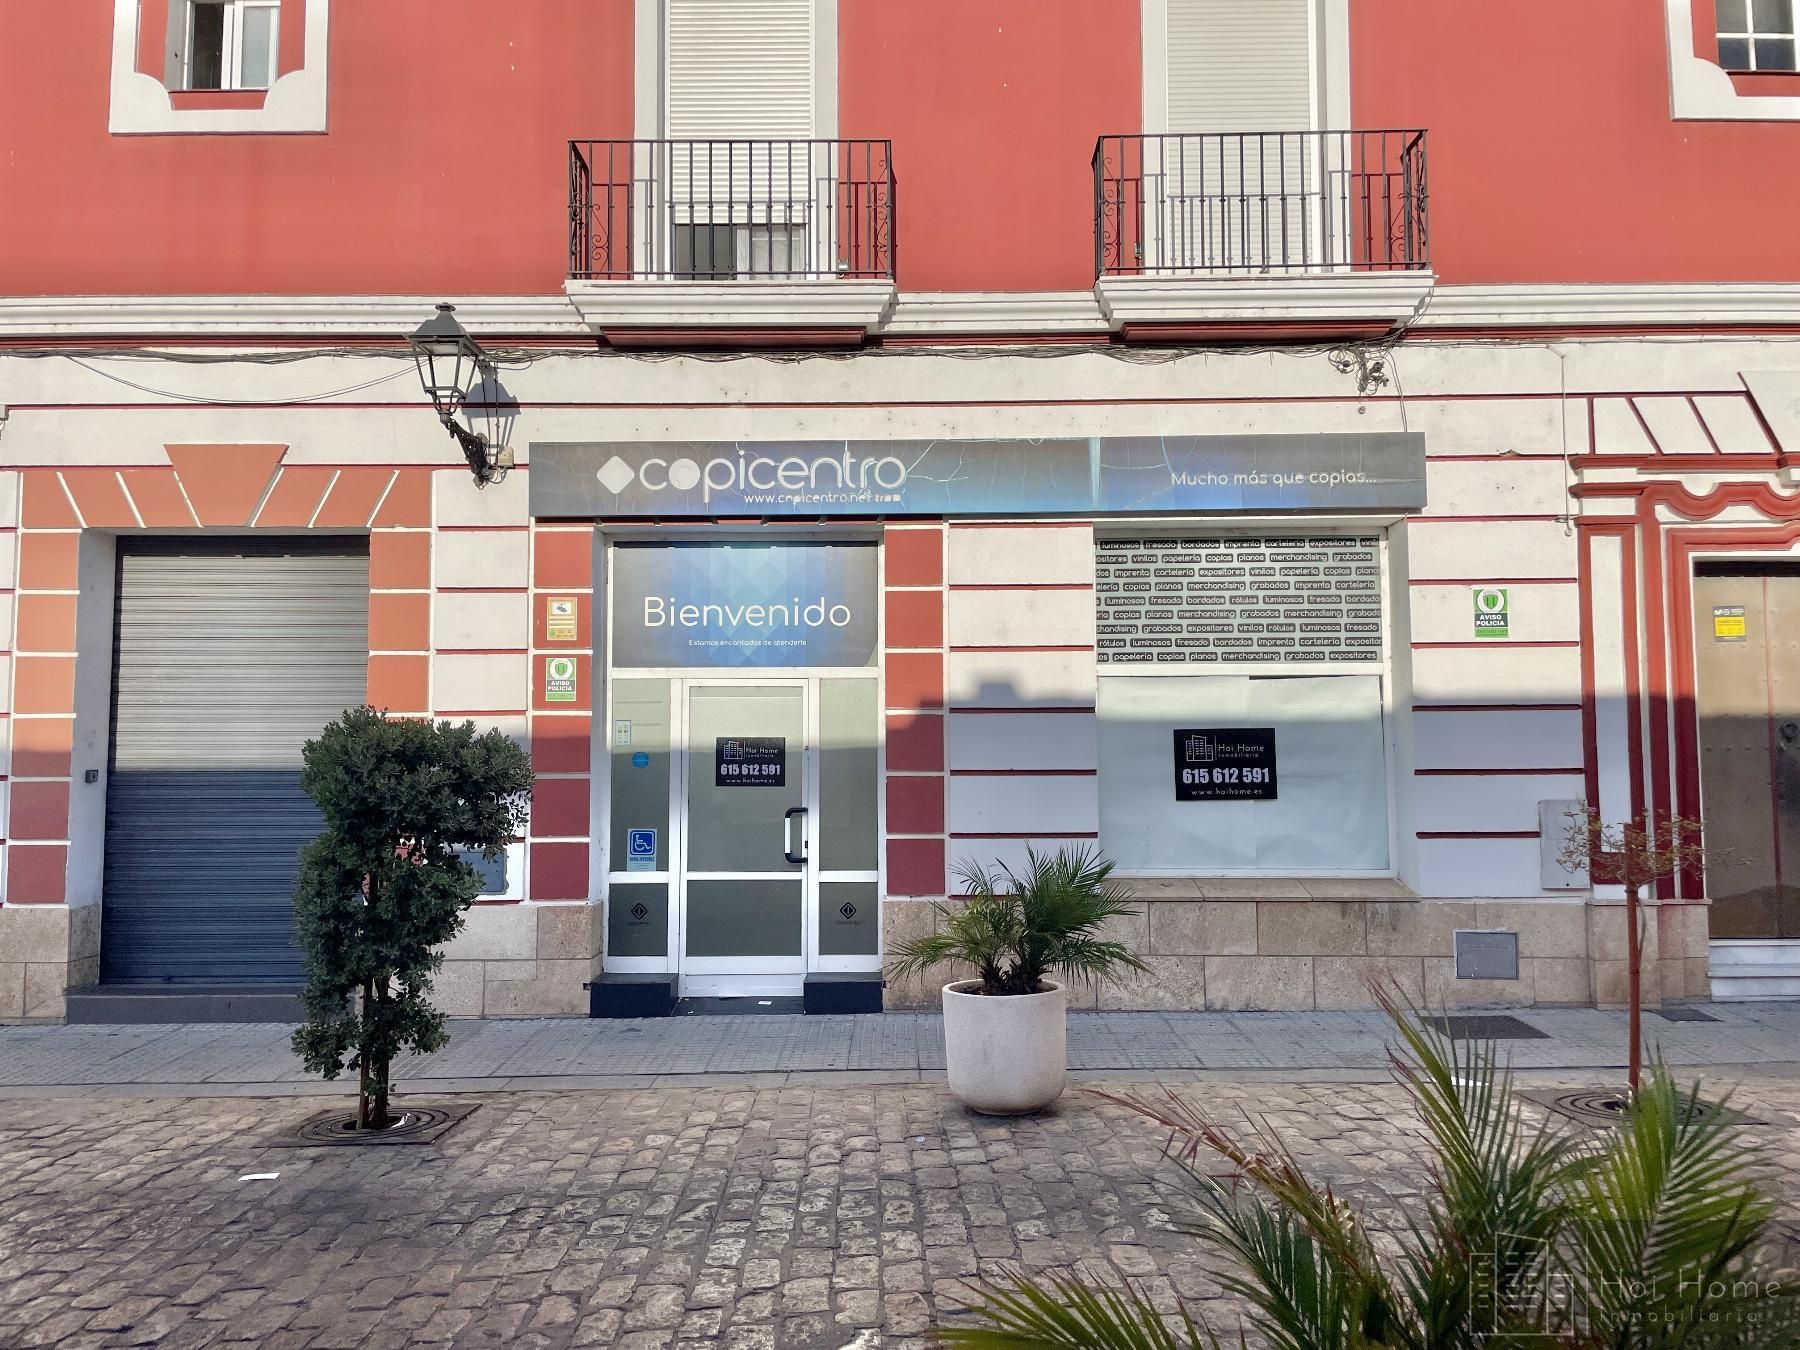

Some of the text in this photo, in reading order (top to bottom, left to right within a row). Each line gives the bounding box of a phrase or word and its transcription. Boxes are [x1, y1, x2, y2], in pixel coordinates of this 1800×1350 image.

[639, 450, 905, 503] copicentro
[1171, 471, 1227, 486] Mucho
[1234, 470, 1267, 485] más
[1273, 473, 1304, 487] que
[1133, 554, 1157, 562] vinilos
[1163, 554, 1200, 563] papelería
[1207, 554, 1232, 562] copias
[1239, 554, 1264, 562] planos
[1271, 553, 1327, 562] merchandising
[1334, 553, 1371, 562] grabados
[1115, 569, 1150, 578] imprenta
[1156, 568, 1193, 576] cartelería
[1200, 568, 1245, 577] expositores
[1281, 567, 1318, 576] papelería
[1325, 567, 1350, 576] copias
[1125, 583, 1150, 591] copias
[1156, 582, 1181, 590] planos
[1188, 582, 1244, 591] merchandising
[1252, 582, 1289, 590] grabados
[1296, 581, 1330, 590] imprenta
[1336, 580, 1375, 589] cartelería
[1151, 596, 1181, 604] fresado
[1188, 596, 1224, 604] bordados
[644, 596, 851, 627] Bienvenido
[1114, 611, 1140, 619] copias
[1147, 611, 1172, 619] planos
[1179, 610, 1235, 619] merchandising
[1242, 610, 1279, 619] grabados
[1285, 610, 1342, 618] merchandising
[1144, 625, 1182, 633] grabados
[1188, 624, 1232, 633] expositores
[1268, 624, 1294, 632] rótulos
[689, 638, 719, 647] Estamos
[763, 638, 773, 647] de
[1178, 638, 1208, 646] fresado
[1215, 638, 1252, 646] bordados
[1258, 638, 1294, 646] imprenta
[1114, 653, 1152, 662] papelería
[1159, 653, 1184, 662] copias
[1190, 653, 1216, 662] planos
[1223, 652, 1279, 661] merchandising
[1286, 652, 1324, 661] grabados
[1330, 652, 1376, 660] expositores
[721, 764, 781, 775] 615 612 591
[1182, 767, 1270, 784] 615 612 591
